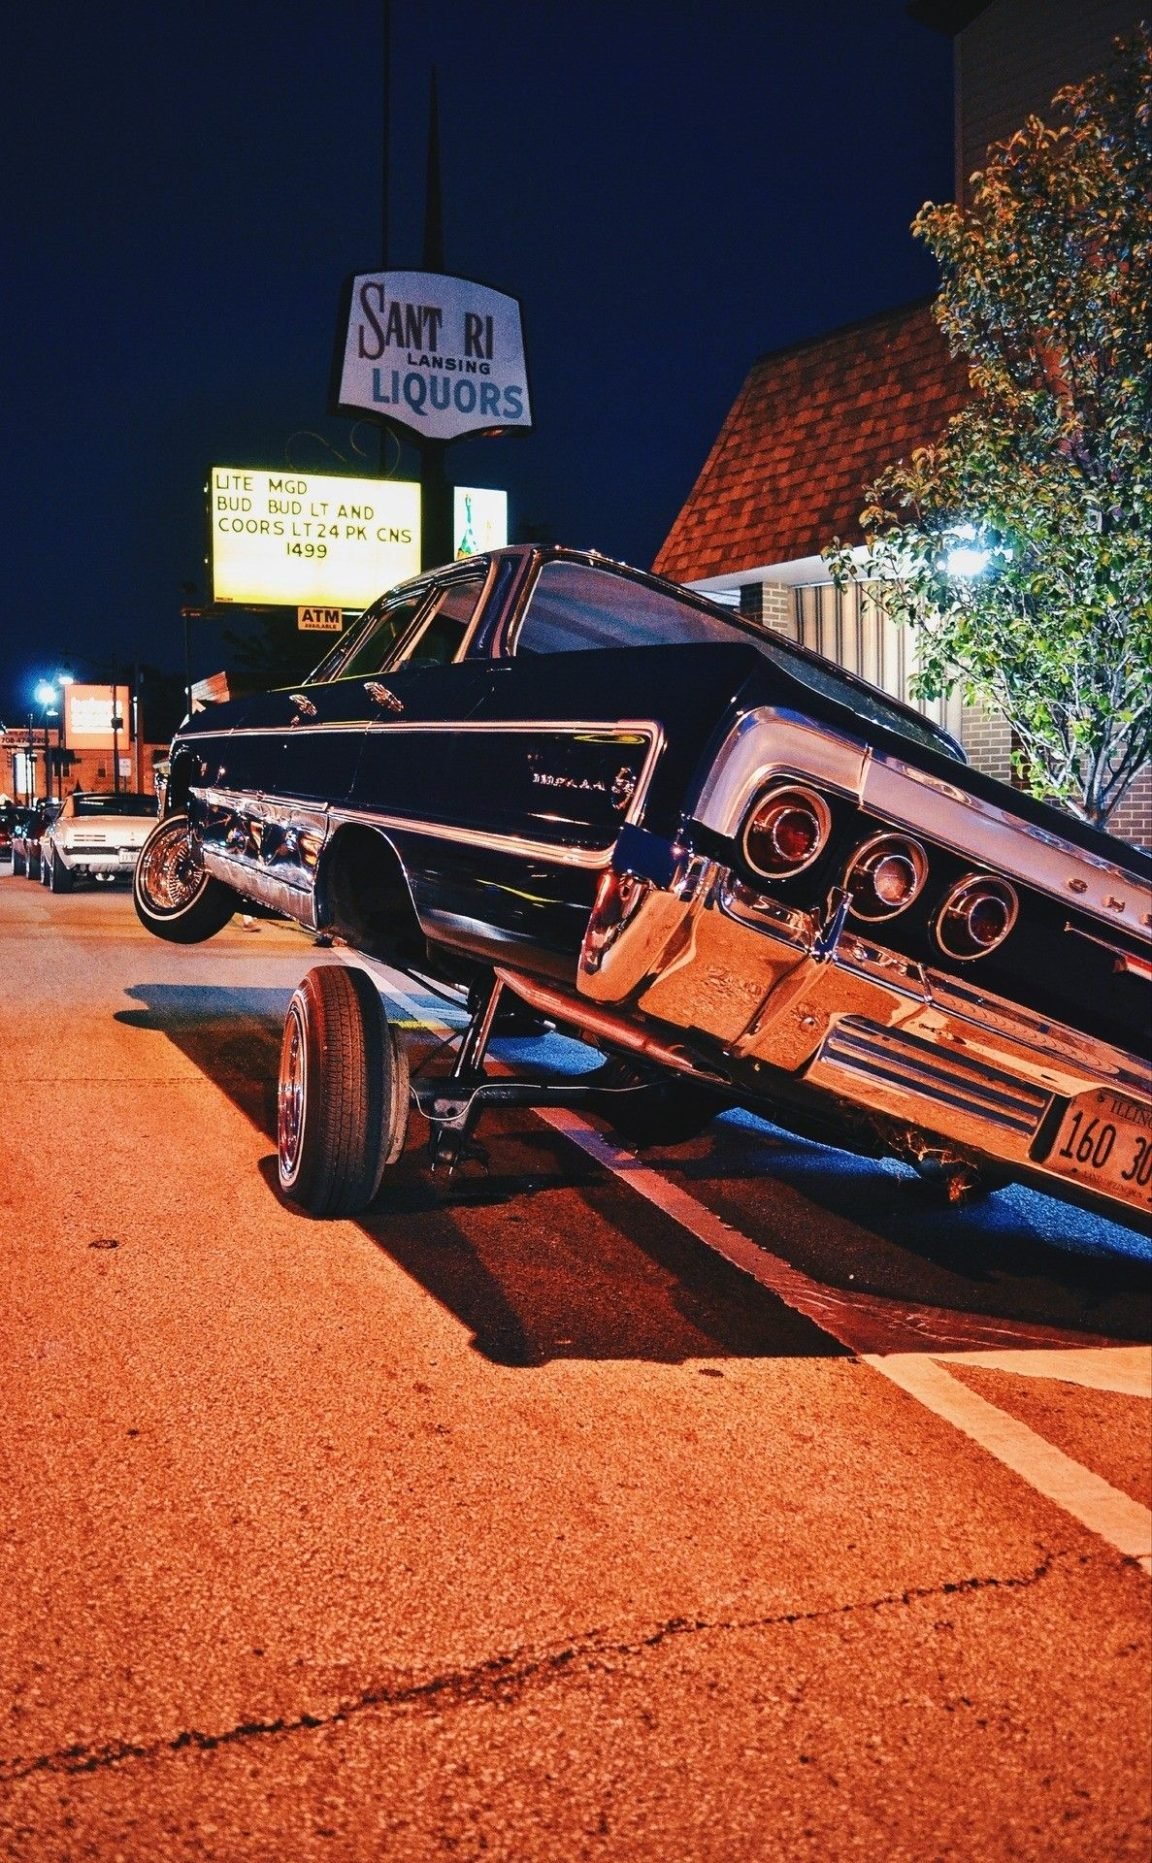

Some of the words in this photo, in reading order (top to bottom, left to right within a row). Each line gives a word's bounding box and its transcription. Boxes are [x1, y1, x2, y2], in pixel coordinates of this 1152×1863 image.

[407, 352, 491, 375] LANSING
[372, 368, 524, 419] LIQUORS
[216, 474, 254, 491] LITE
[268, 478, 308, 495] MGD
[217, 496, 252, 512] BUD
[268, 499, 302, 515] BUD
[310, 502, 329, 517] LT
[337, 504, 375, 521] AND
[218, 517, 285, 536] COORS
[292, 522, 313, 537] LT
[317, 523, 339, 539] 24
[346, 526, 367, 541] PK
[376, 527, 412, 543] CNS
[286, 542, 328, 559] 1499
[301, 609, 340, 624] ATM
[1060, 1111, 1117, 1169] 160
